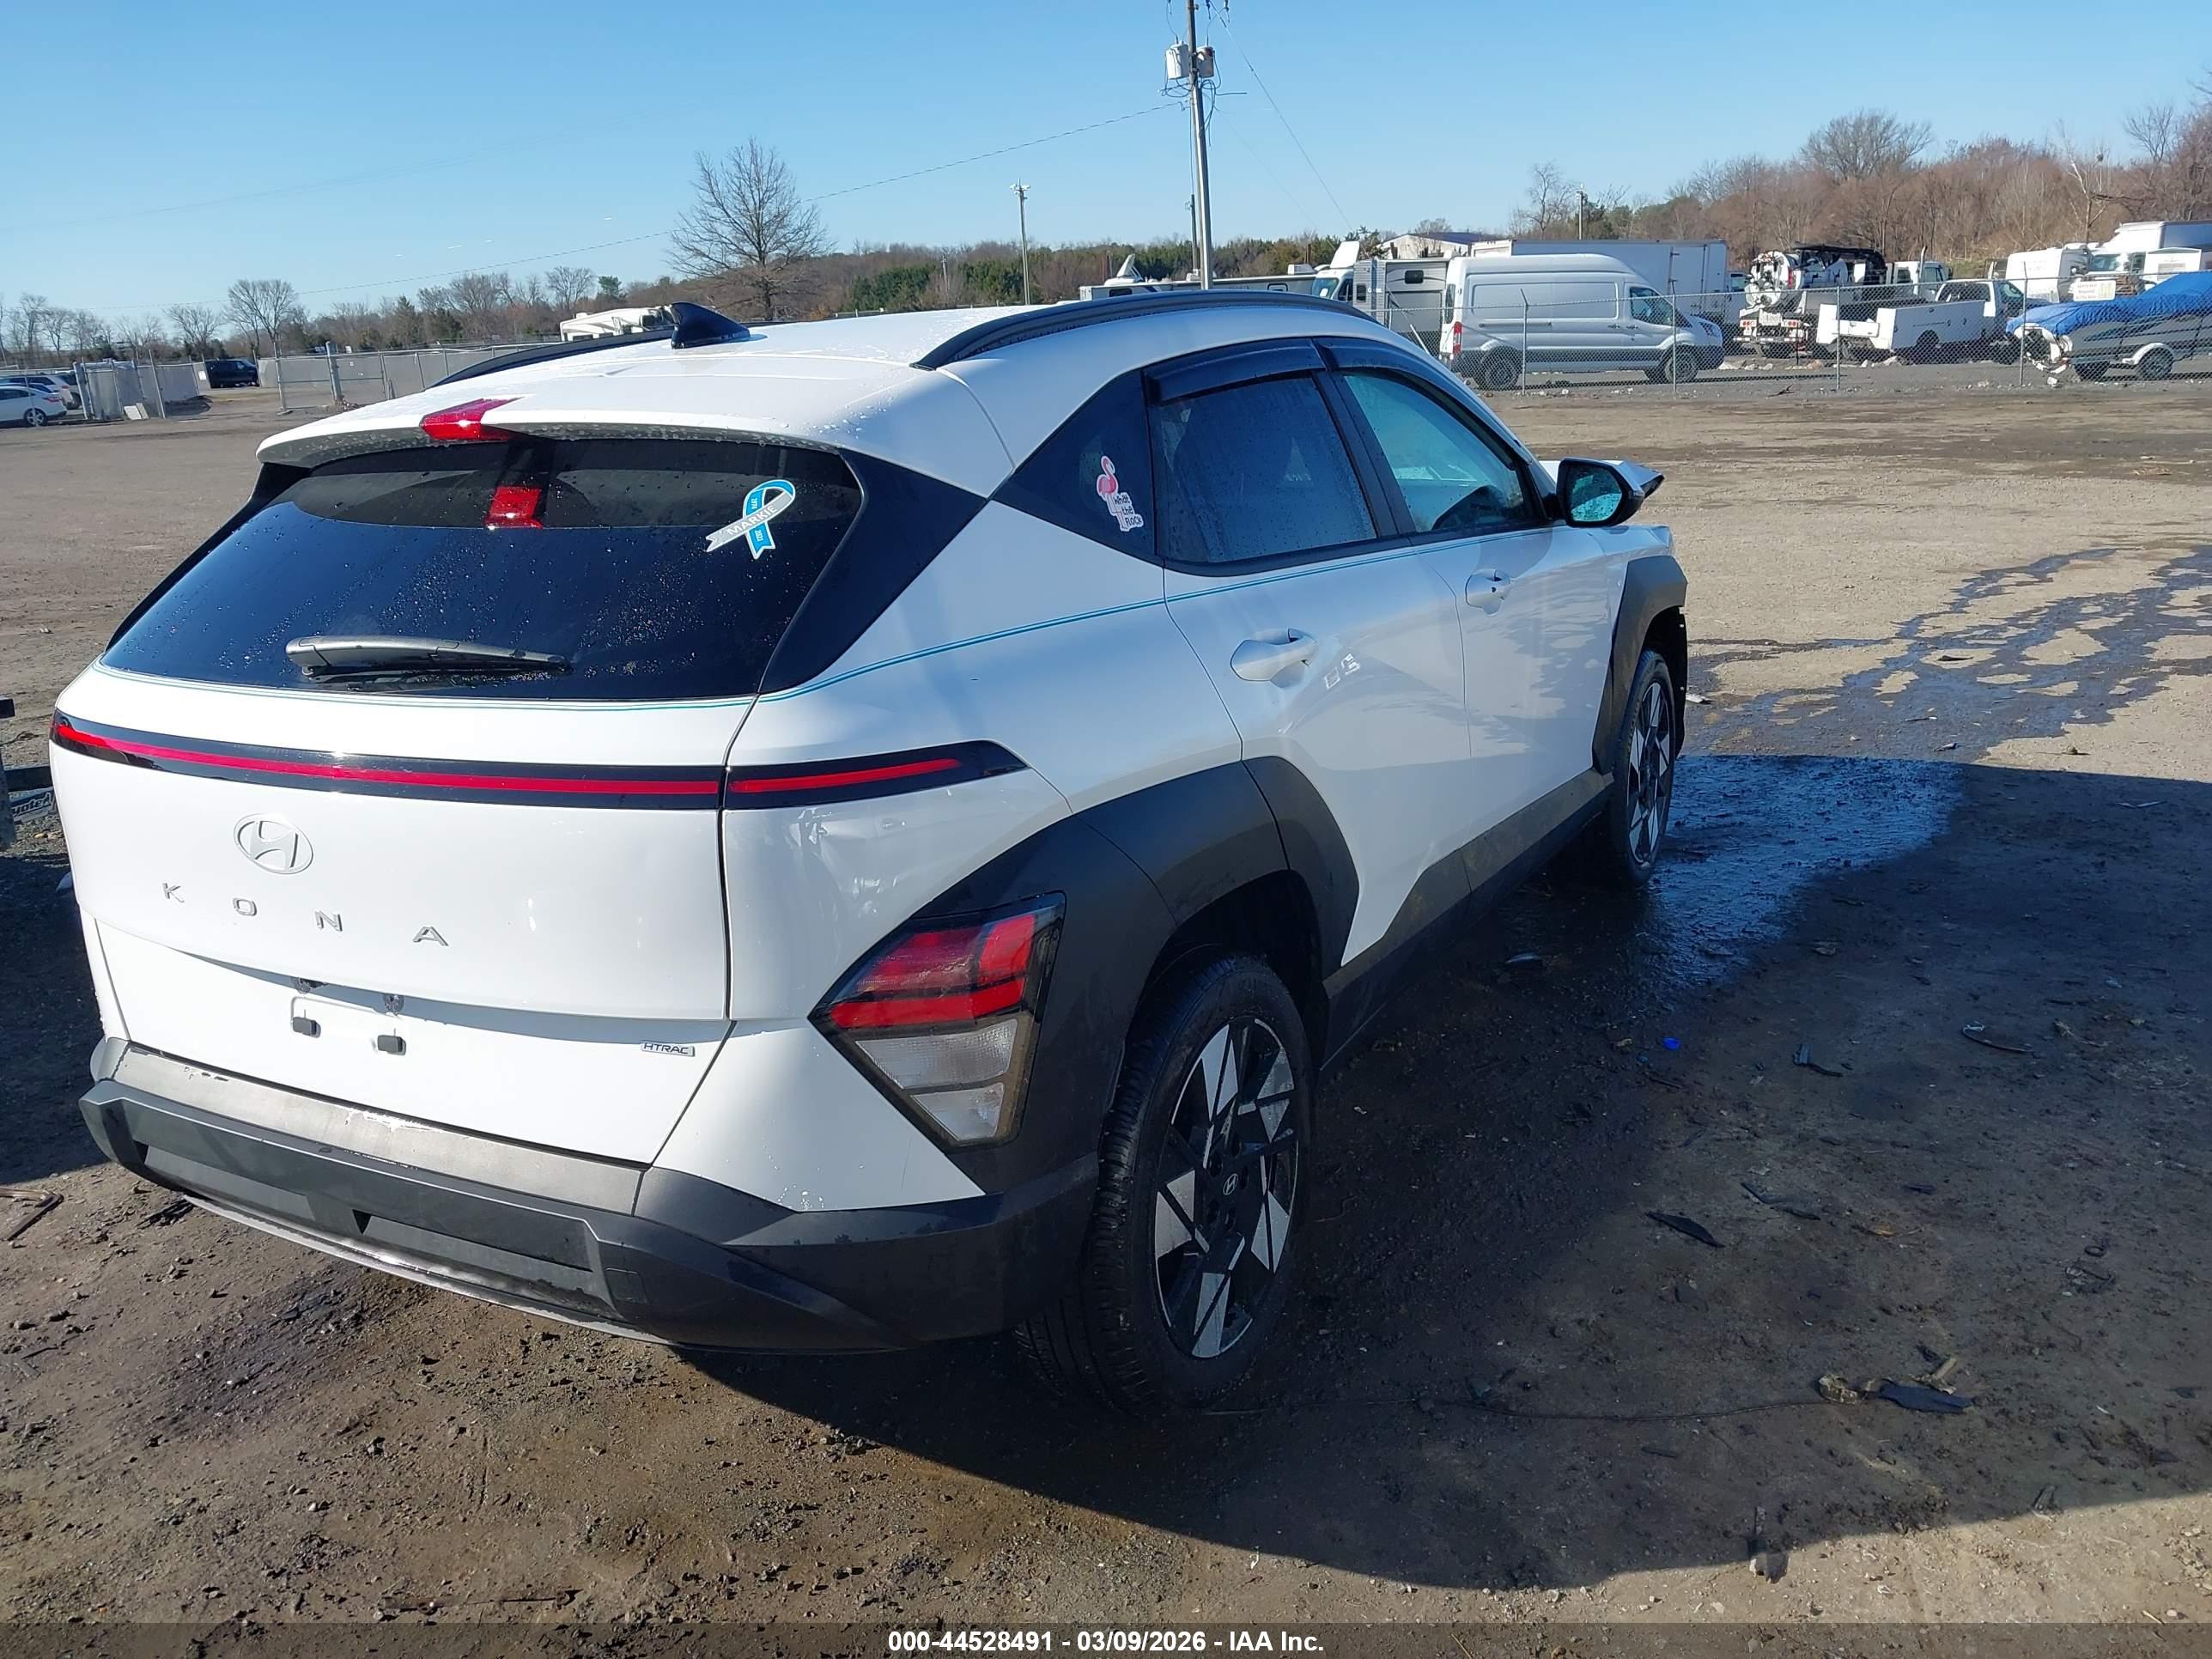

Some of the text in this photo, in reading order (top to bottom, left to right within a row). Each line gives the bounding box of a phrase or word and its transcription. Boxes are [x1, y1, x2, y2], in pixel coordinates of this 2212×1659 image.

[726, 505, 777, 535] MARKIE
[1122, 505, 1133, 516] the
[161, 882, 449, 946] KONA
[643, 1042, 690, 1054] HTRAC
